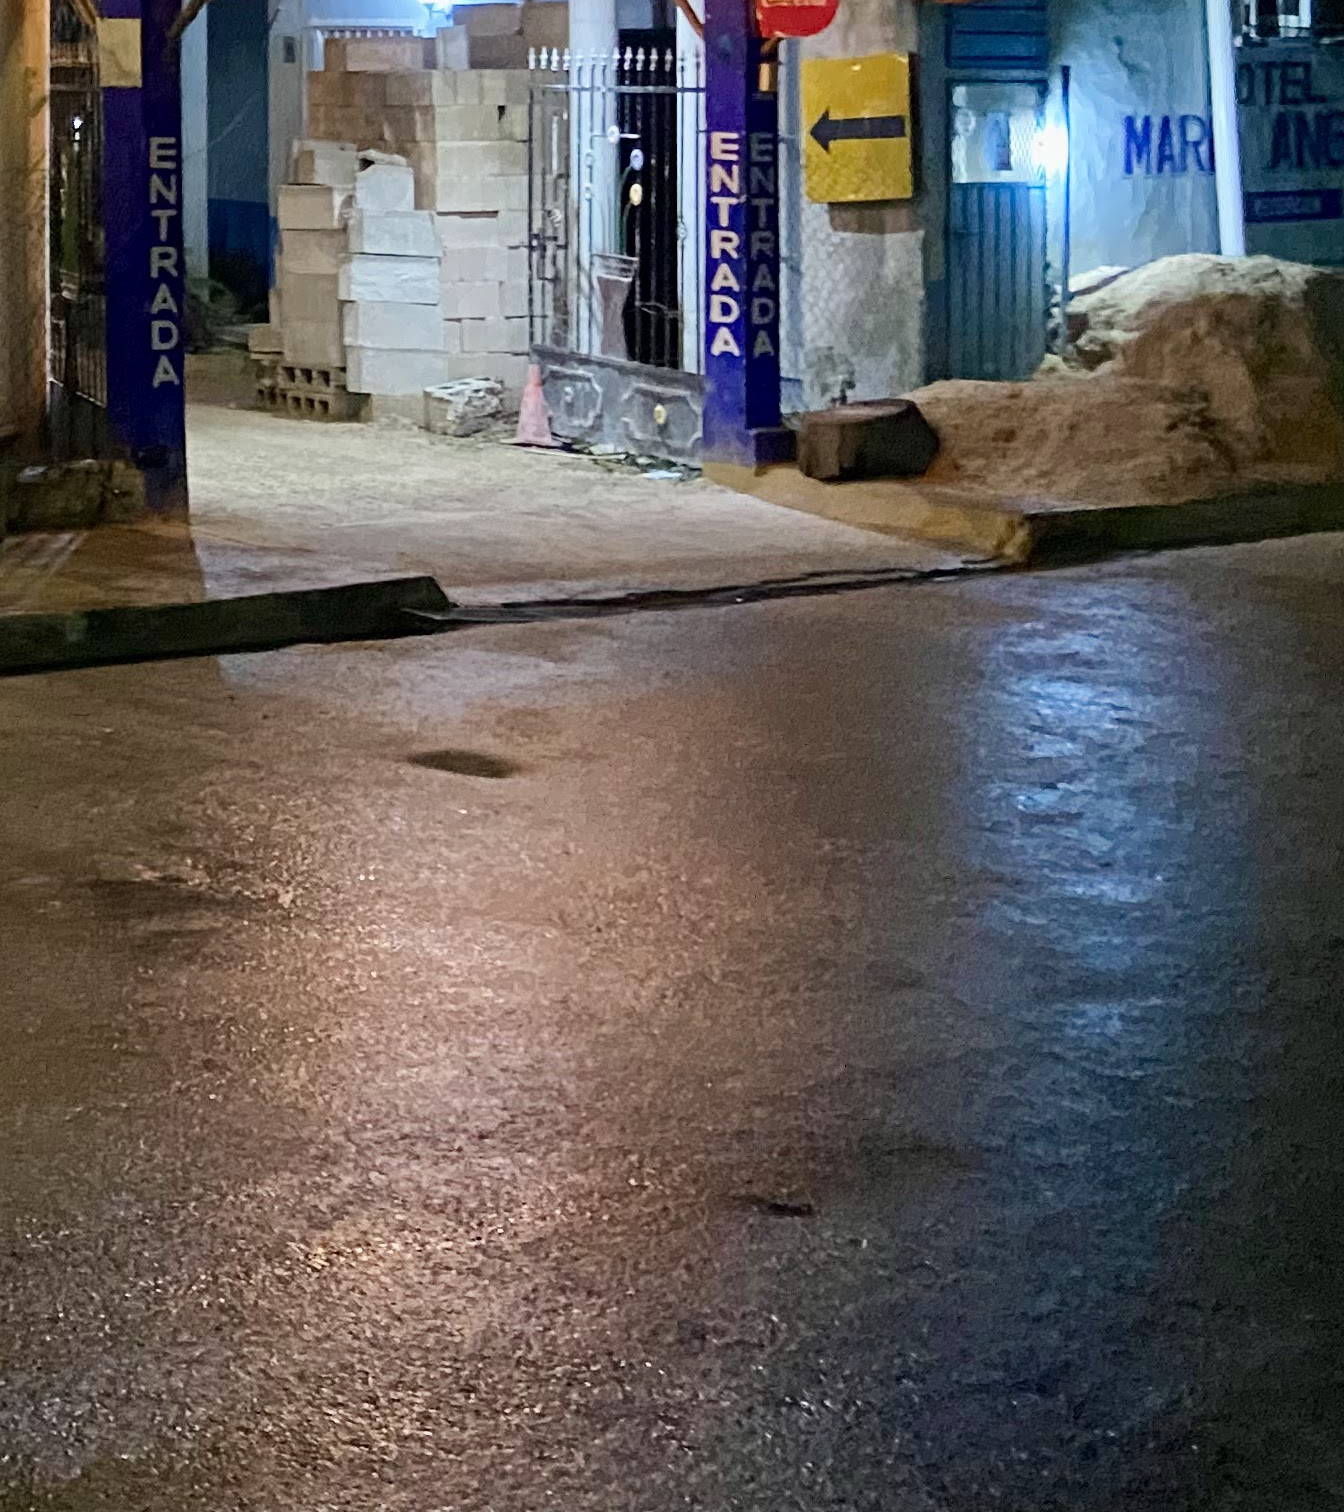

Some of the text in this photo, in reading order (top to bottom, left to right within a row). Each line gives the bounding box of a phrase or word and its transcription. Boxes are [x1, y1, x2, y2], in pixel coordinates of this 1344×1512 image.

[1235, 61, 1327, 106] OTEL
[149, 136, 179, 389] ENTRADA
[708, 131, 740, 357] ENTRADA
[749, 131, 776, 359] ENTRADA
